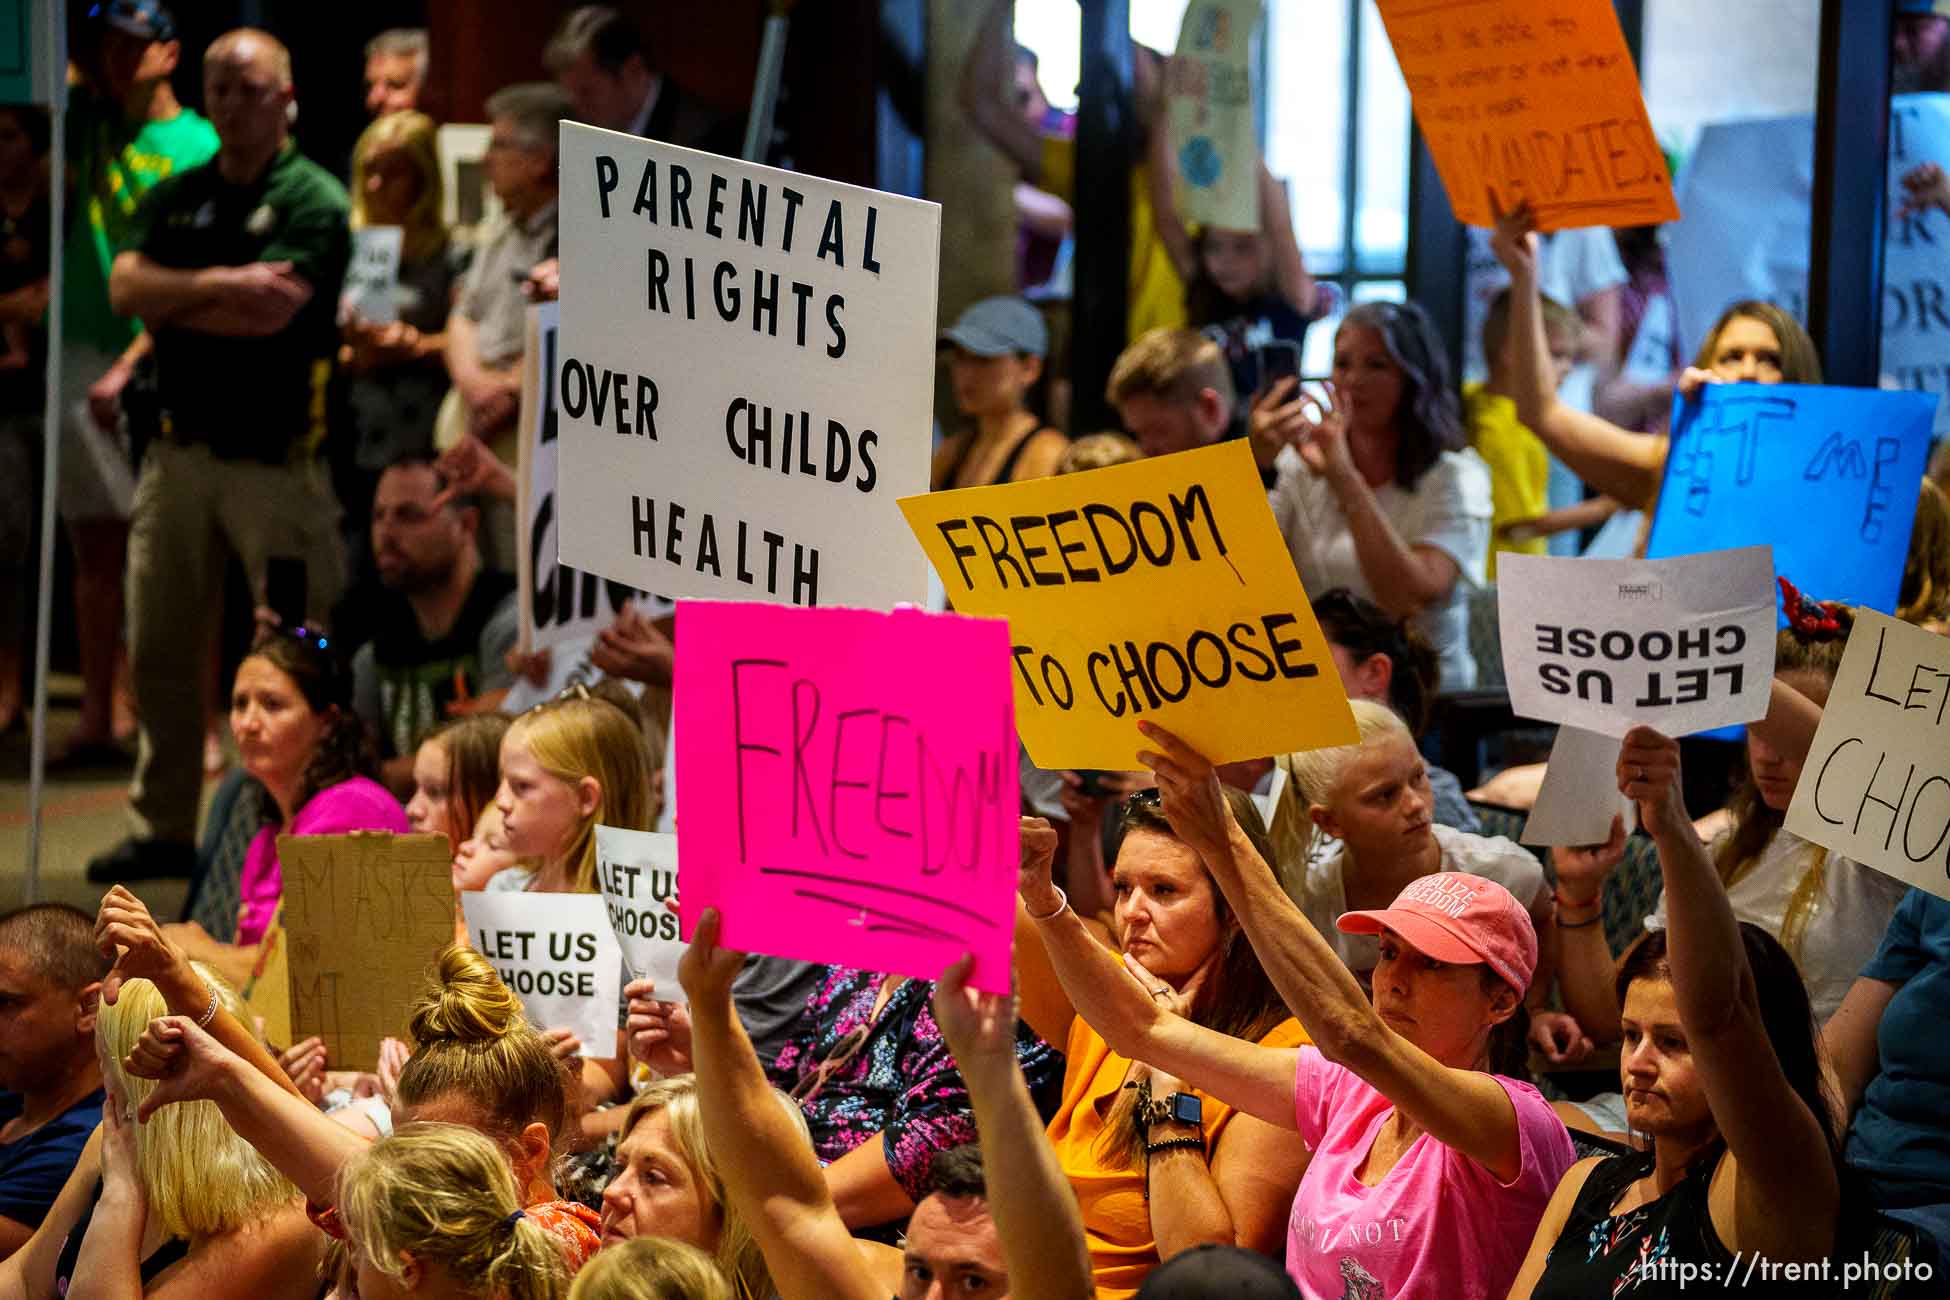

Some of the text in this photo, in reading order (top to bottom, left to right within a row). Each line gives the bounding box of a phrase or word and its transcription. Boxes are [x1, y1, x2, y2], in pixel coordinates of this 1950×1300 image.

[596, 155, 881, 274] PARENTAL
[648, 248, 847, 359] RIGHTS
[561, 358, 659, 442] OVER
[726, 397, 878, 492] CHILDS
[631, 495, 819, 607] HEALTH
[937, 484, 1246, 591] FREEDOM
[1012, 613, 1320, 718] TO CHOOSE
[1535, 624, 1747, 662] CHOOSE
[1538, 662, 1745, 708] LET US
[1815, 738, 1950, 879] CHO
[603, 861, 680, 902] LET U
[479, 929, 598, 962] LET US
[608, 903, 683, 942] CHOOS
[499, 968, 595, 997] HOOSE
[1346, 1217, 1405, 1247] NOT
